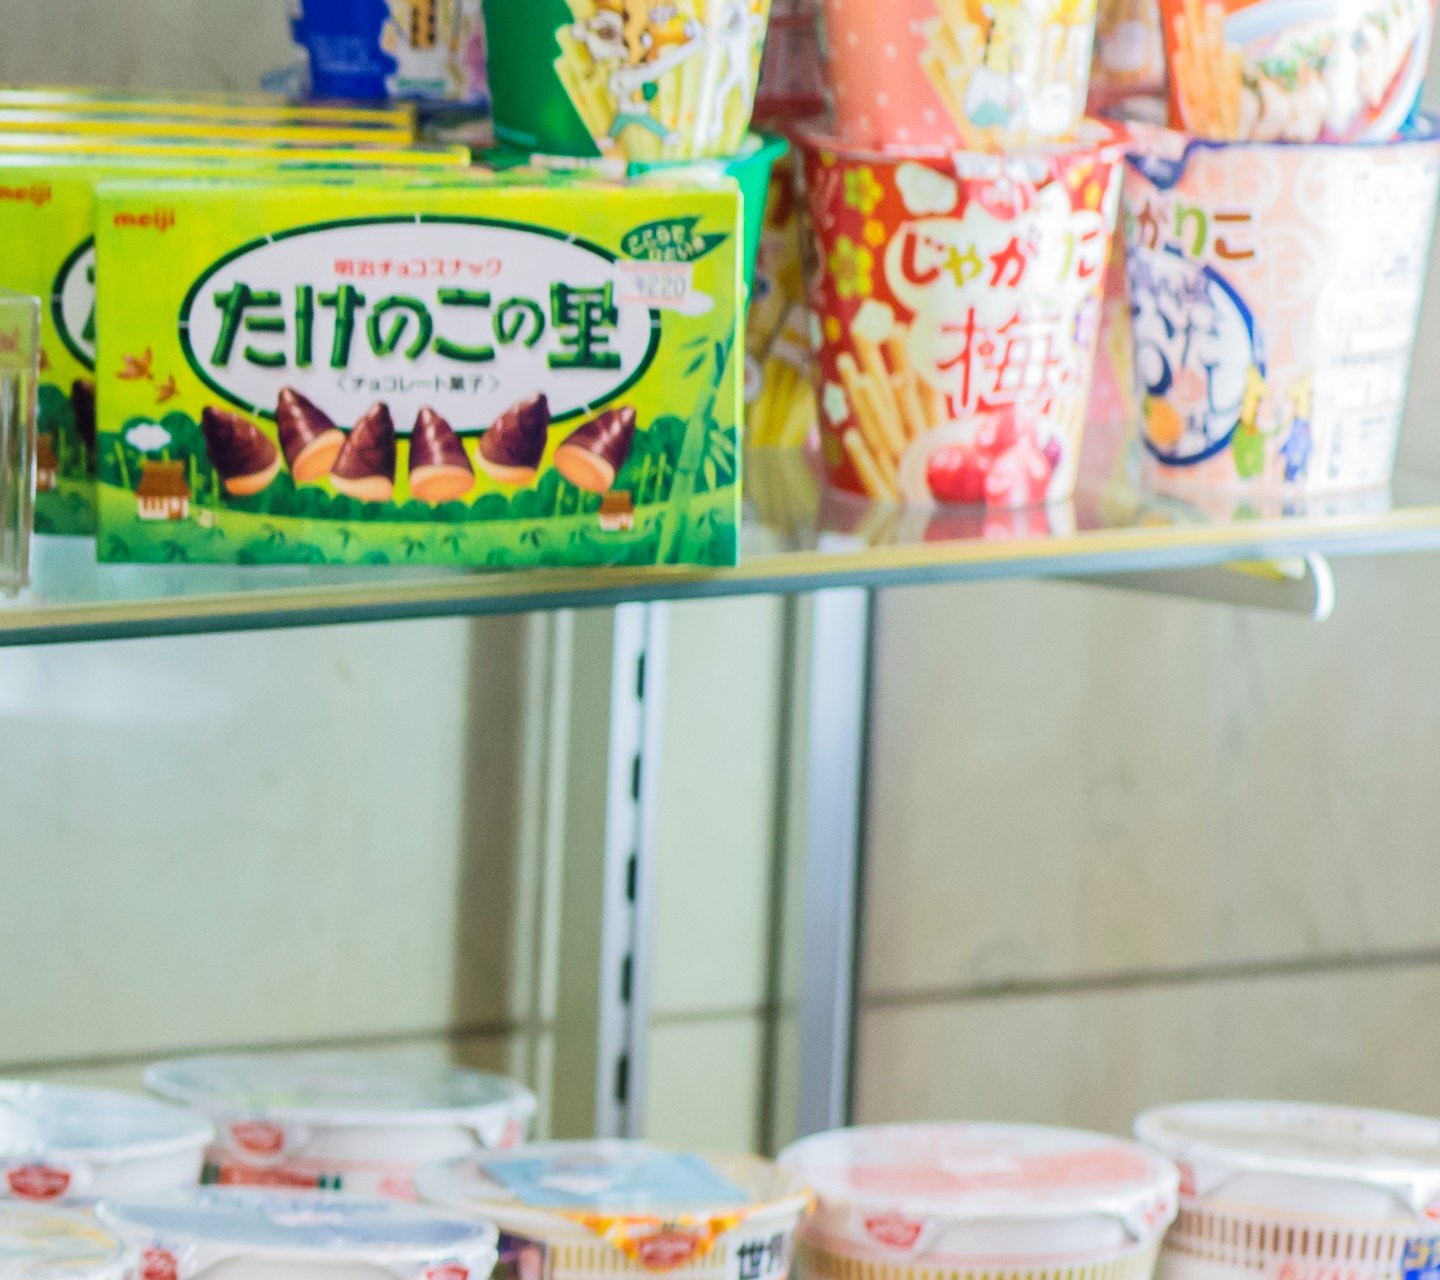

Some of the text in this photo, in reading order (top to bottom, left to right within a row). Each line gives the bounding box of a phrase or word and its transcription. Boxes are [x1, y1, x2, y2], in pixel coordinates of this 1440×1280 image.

[112, 207, 176, 232] meiji
[332, 256, 504, 279] 明治チョコスナック
[210, 281, 622, 372] たけのこの里
